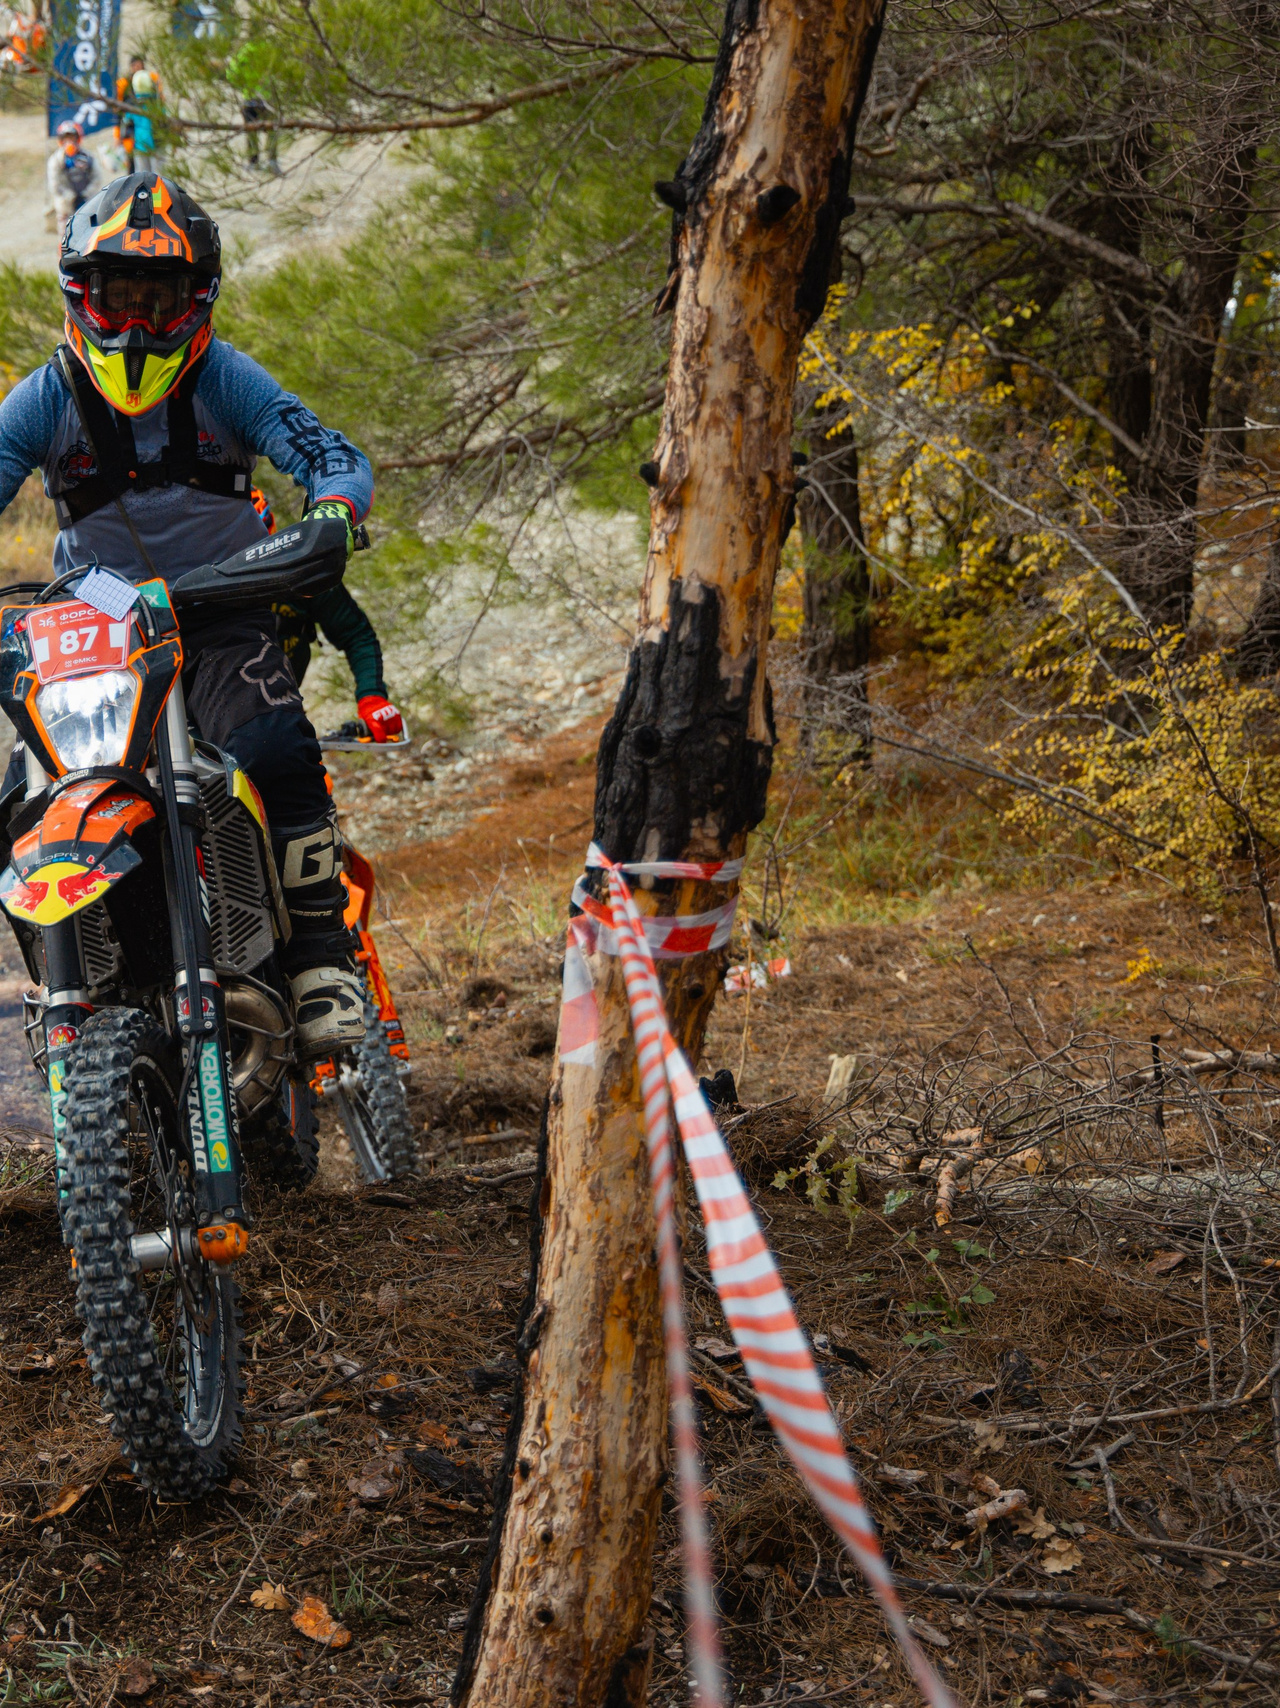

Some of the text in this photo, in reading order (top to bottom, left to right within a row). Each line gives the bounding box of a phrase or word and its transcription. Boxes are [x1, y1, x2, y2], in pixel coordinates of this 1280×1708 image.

[245, 531, 300, 561] 2Takta
[60, 625, 99, 655] 87
[372, 705, 400, 721] FOX
[199, 1046, 229, 1141] MOTOREX
[224, 1051, 239, 1116] ATHENA
